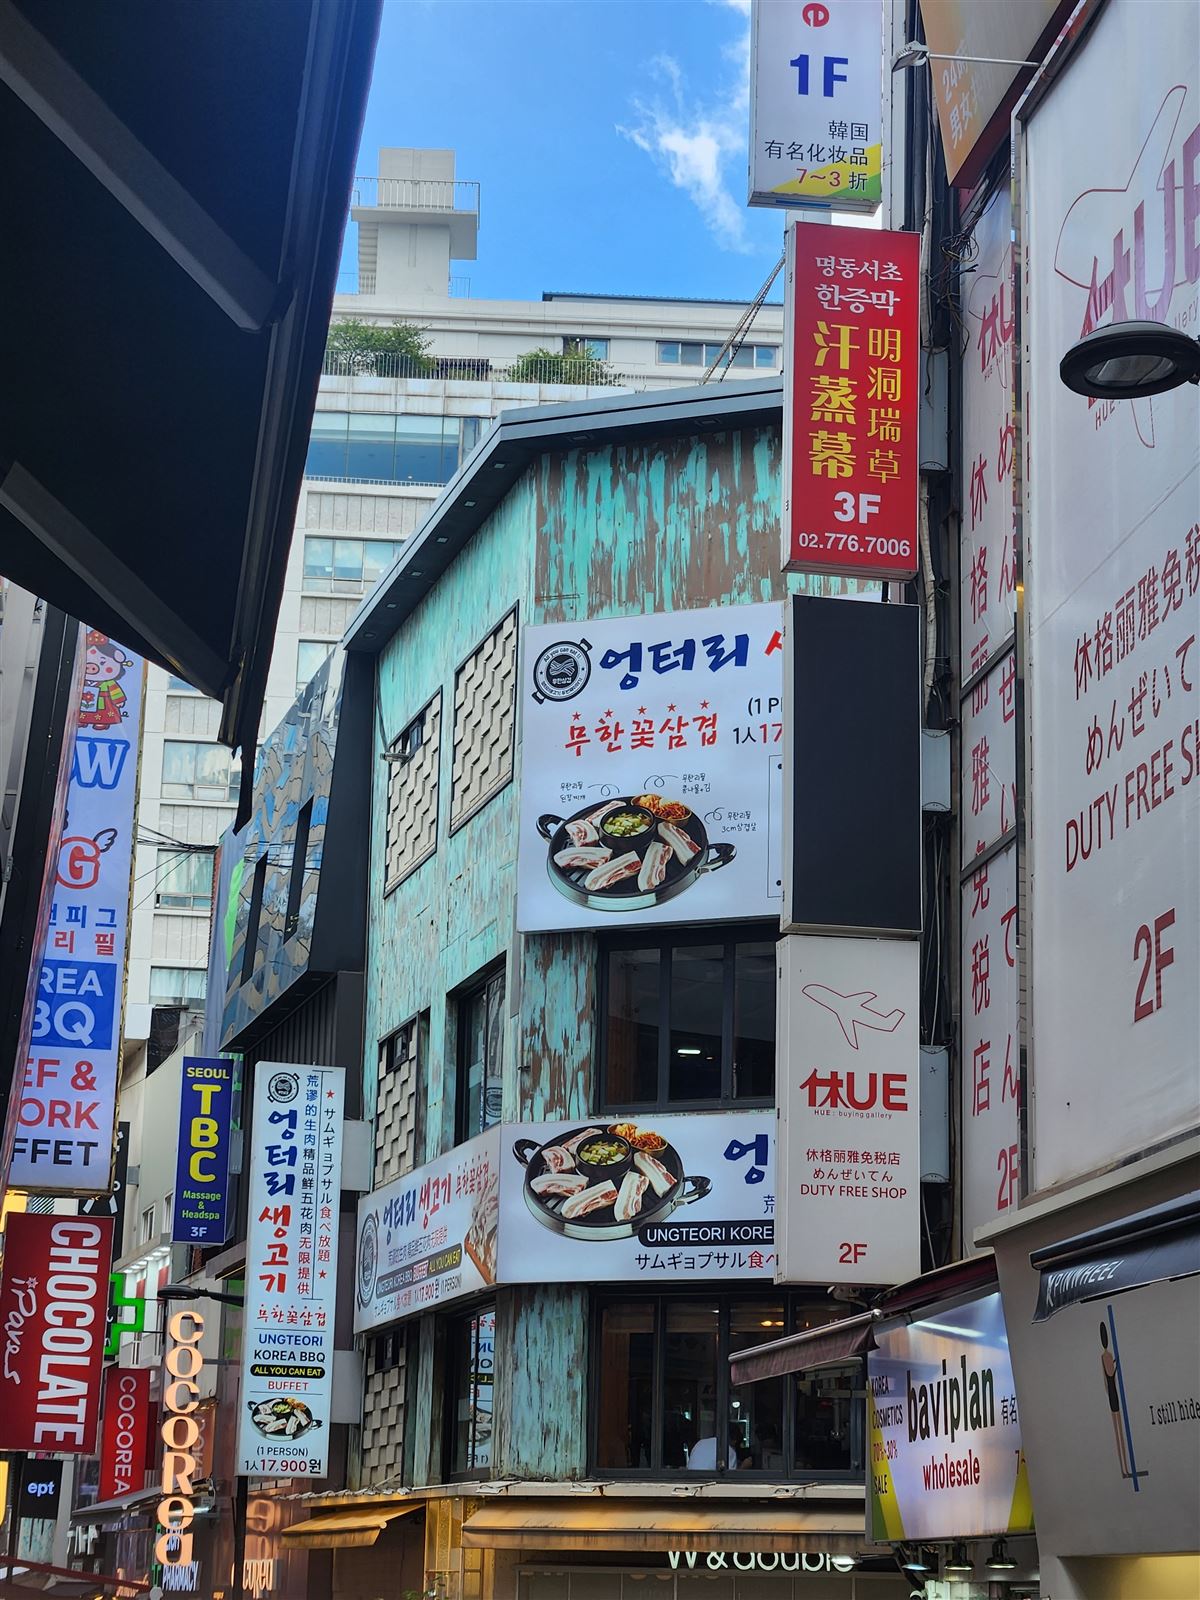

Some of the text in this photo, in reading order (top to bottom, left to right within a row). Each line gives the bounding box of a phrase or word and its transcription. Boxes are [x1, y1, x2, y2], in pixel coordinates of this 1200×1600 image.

[790, 54, 849, 98] 1F
[828, 120, 869, 142] 韓国
[764, 140, 868, 166] 有名化妆品
[849, 172, 868, 192] 折
[815, 255, 904, 282] 명동서초
[814, 284, 901, 317] 한증막
[809, 320, 861, 479] 汗蒸幕
[867, 328, 902, 484] 明洞瑞草
[833, 491, 882, 524] 3F
[798, 532, 911, 557] 02.776.7006
[599, 633, 750, 691] 엉터리
[768, 697, 783, 714] P
[565, 712, 718, 757] 무한꽃삼겹
[1066, 783, 1118, 873] DUTY
[1125, 739, 1175, 829] FREE
[1133, 907, 1176, 1024] 2F
[70, 1060, 98, 1092] &
[186, 1066, 230, 1080] SEOUL
[838, 1110, 864, 1120] buying
[865, 1111, 893, 1121] gallery
[263, 1109, 298, 1197] 엉터리
[806, 1148, 901, 1166] 休格丽雅免税店
[812, 1168, 894, 1183] めんぜいてん
[183, 1189, 222, 1200] Massage
[800, 1183, 907, 1199] DUTY FREE SHOP
[182, 1209, 220, 1220] Headspa
[197, 1201, 206, 1210] &
[190, 1226, 208, 1238] 3F
[646, 1225, 775, 1243] UNGTEORI KORE
[258, 1204, 292, 1294] 생고기
[838, 1242, 868, 1264] 2F
[256, 1309, 327, 1327] 무한꽃삼겹
[33, 1221, 102, 1446] CHOCOLATE
[258, 1333, 323, 1347] UNGTEORI
[253, 1349, 326, 1364] KOREA BBQ
[253, 1366, 322, 1377] ALL YOU CAN EAT
[267, 1381, 309, 1392] BUFFET
[906, 1354, 996, 1443] baviplan
[872, 1403, 904, 1430] COSMETICS
[1149, 1398, 1200, 1425] I still hide
[113, 1375, 137, 1495] COCOREA
[266, 1446, 309, 1457] PERSON)
[922, 1449, 981, 1491] wholesale
[27, 1480, 55, 1498] ept
[874, 1474, 888, 1495] SALE
